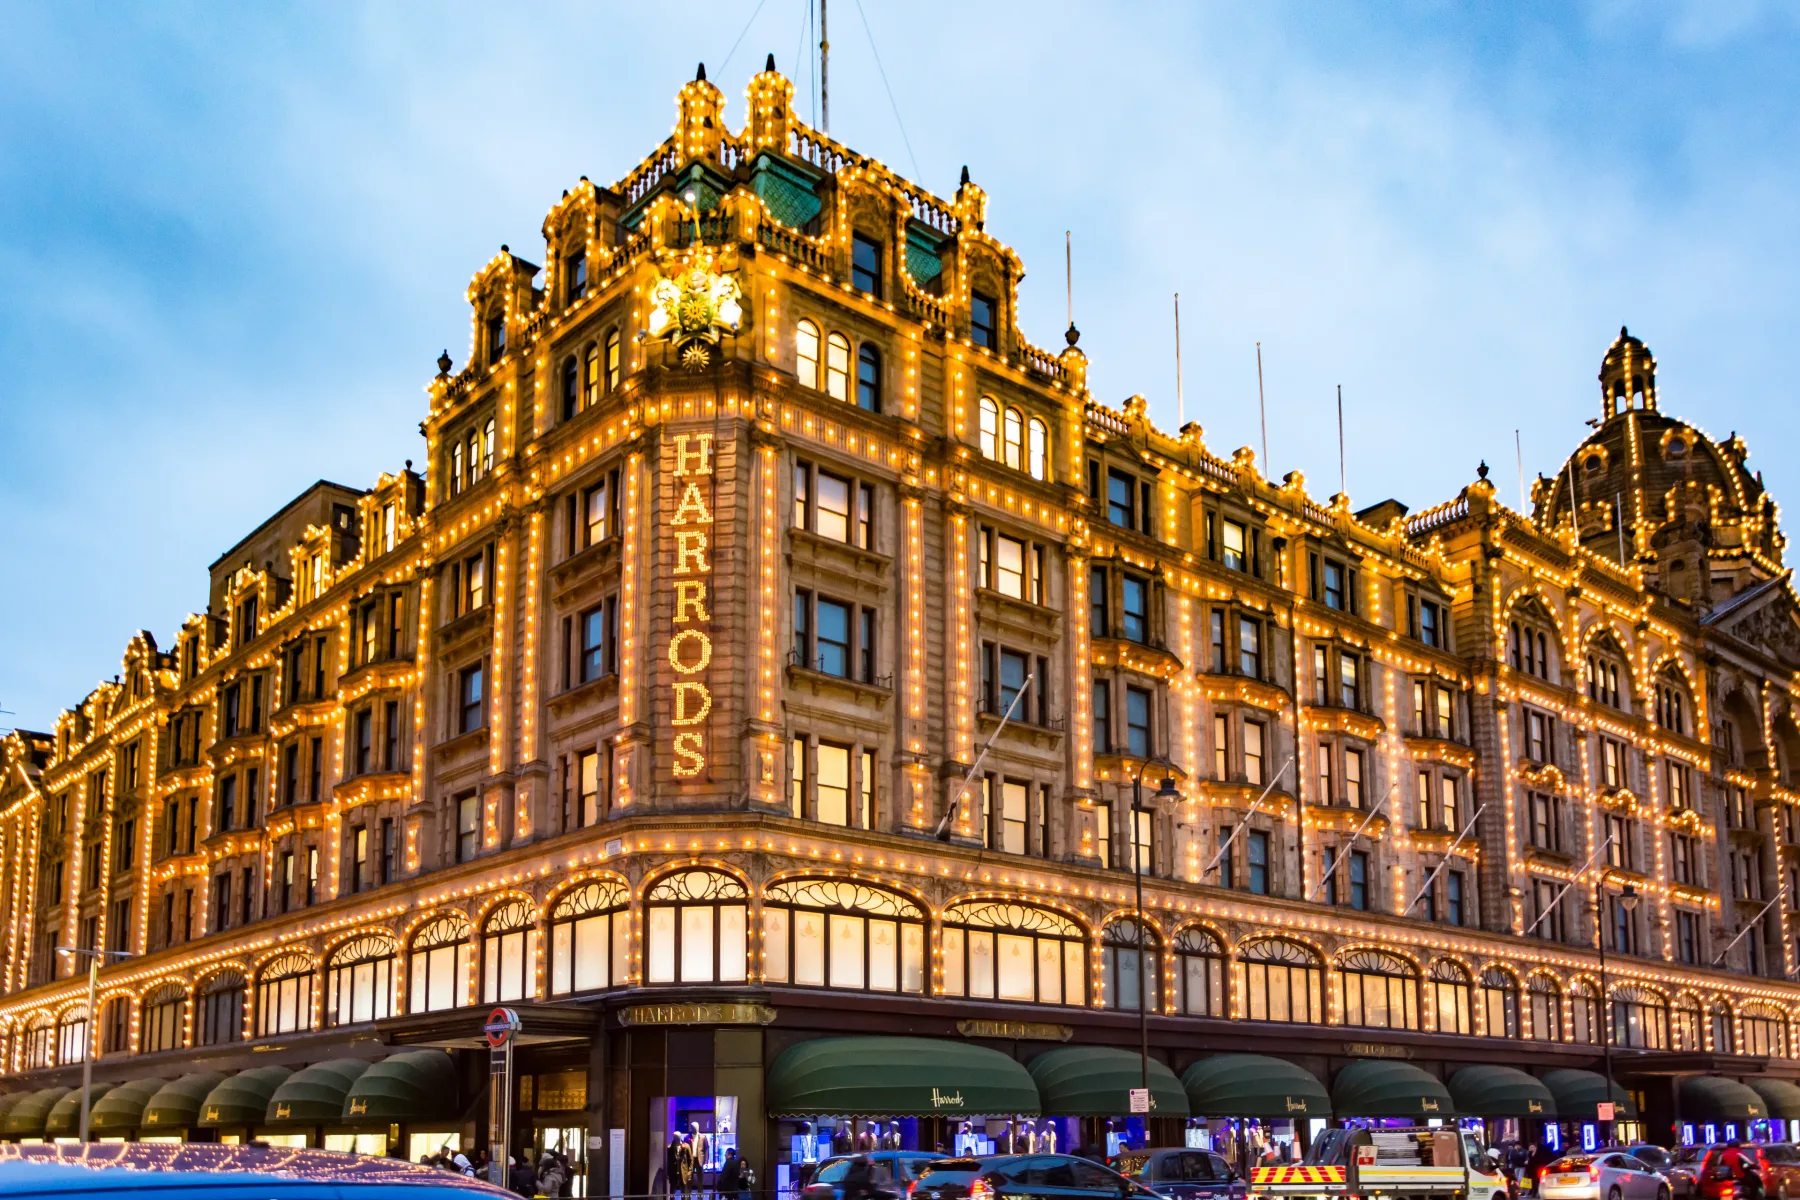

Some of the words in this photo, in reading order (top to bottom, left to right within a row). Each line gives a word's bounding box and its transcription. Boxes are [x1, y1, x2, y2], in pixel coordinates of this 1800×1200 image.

[668, 433, 714, 776] HARRODS
[633, 1006, 723, 1023] HARRODS
[930, 1088, 964, 1107] Harrods
